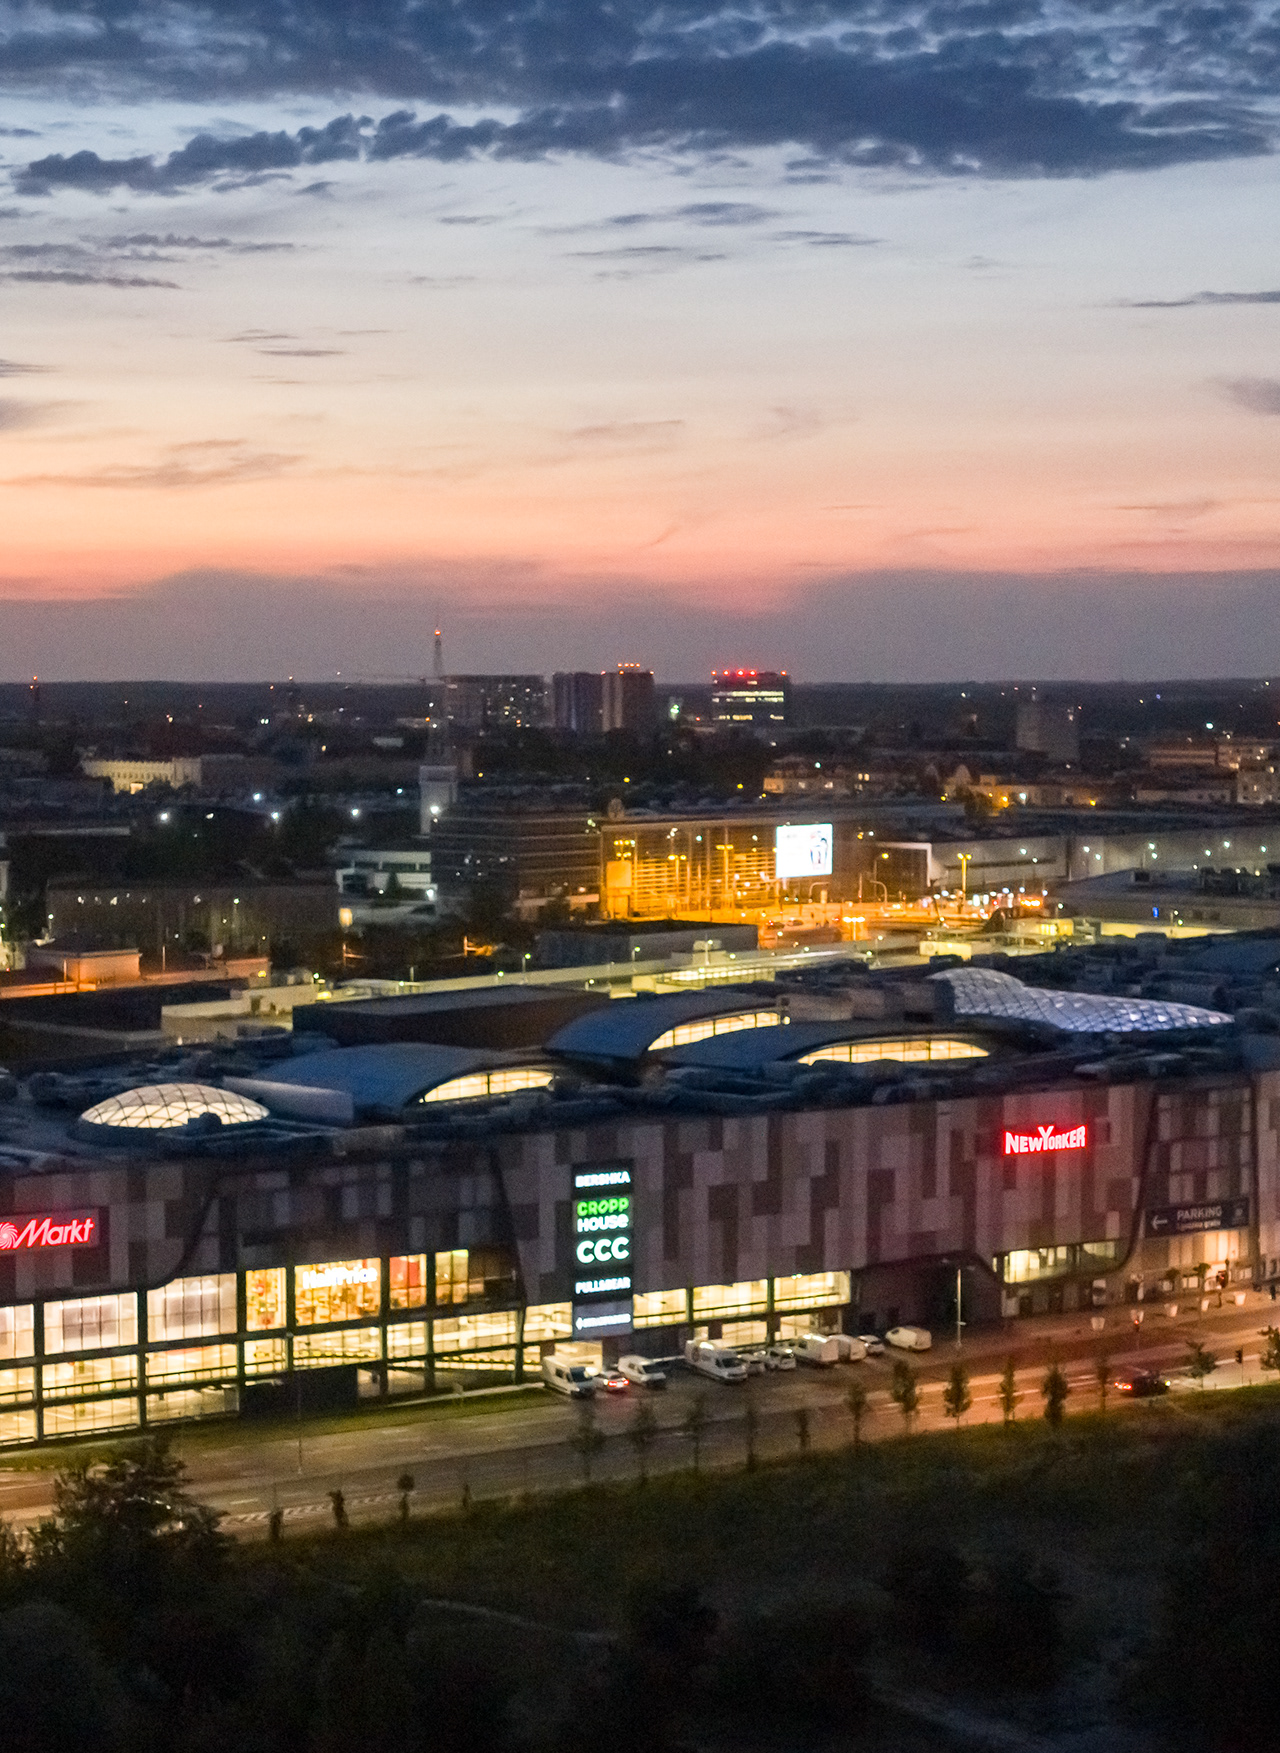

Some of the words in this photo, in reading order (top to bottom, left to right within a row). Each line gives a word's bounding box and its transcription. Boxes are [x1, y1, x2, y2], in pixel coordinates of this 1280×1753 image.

[577, 1197, 629, 1216] CROPP
[1177, 1206, 1223, 1220] PARKING
[576, 1236, 630, 1264] CCC
